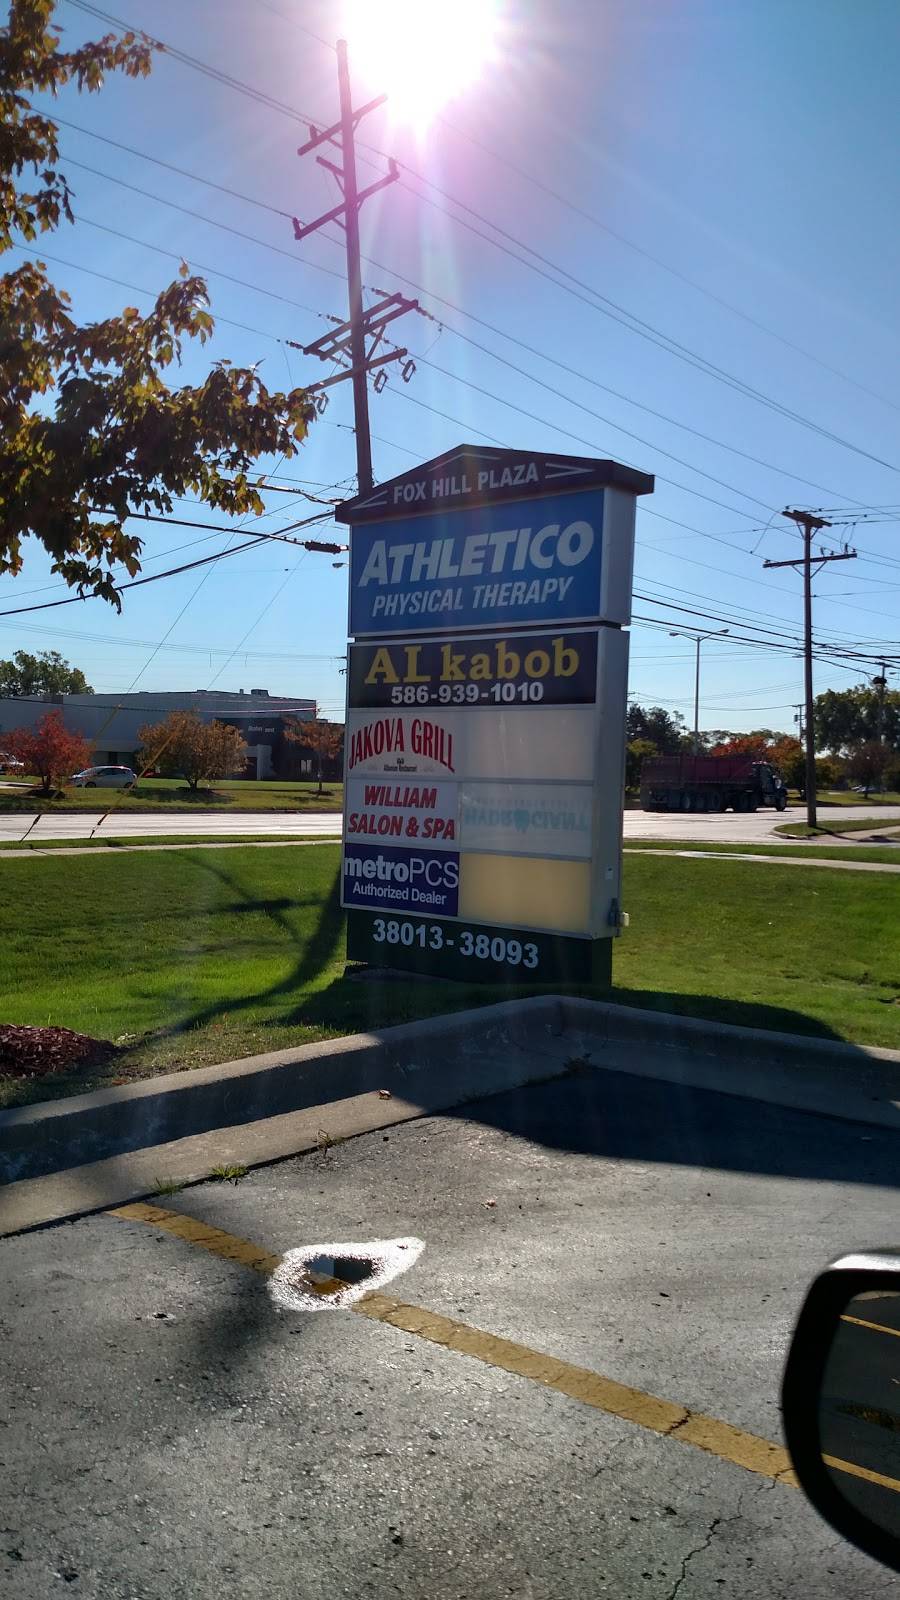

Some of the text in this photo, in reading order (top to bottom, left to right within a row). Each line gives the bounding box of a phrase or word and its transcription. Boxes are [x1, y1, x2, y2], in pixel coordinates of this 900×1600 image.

[393, 462, 540, 505] FOX HILL PLAZA
[358, 521, 595, 588] ATHLETICO
[372, 576, 575, 617] PHYSICAL THERAPY
[440, 637, 580, 682] kabob
[391, 681, 544, 705] 586-939-1010
[349, 717, 456, 774] JAKOVA GRILL
[364, 785, 438, 809] WILLIAM
[348, 813, 403, 836] SALON
[405, 819, 419, 838] &
[421, 817, 456, 840] SPA
[344, 854, 459, 889] metroPCS
[352, 881, 447, 906] Authorized Dealer
